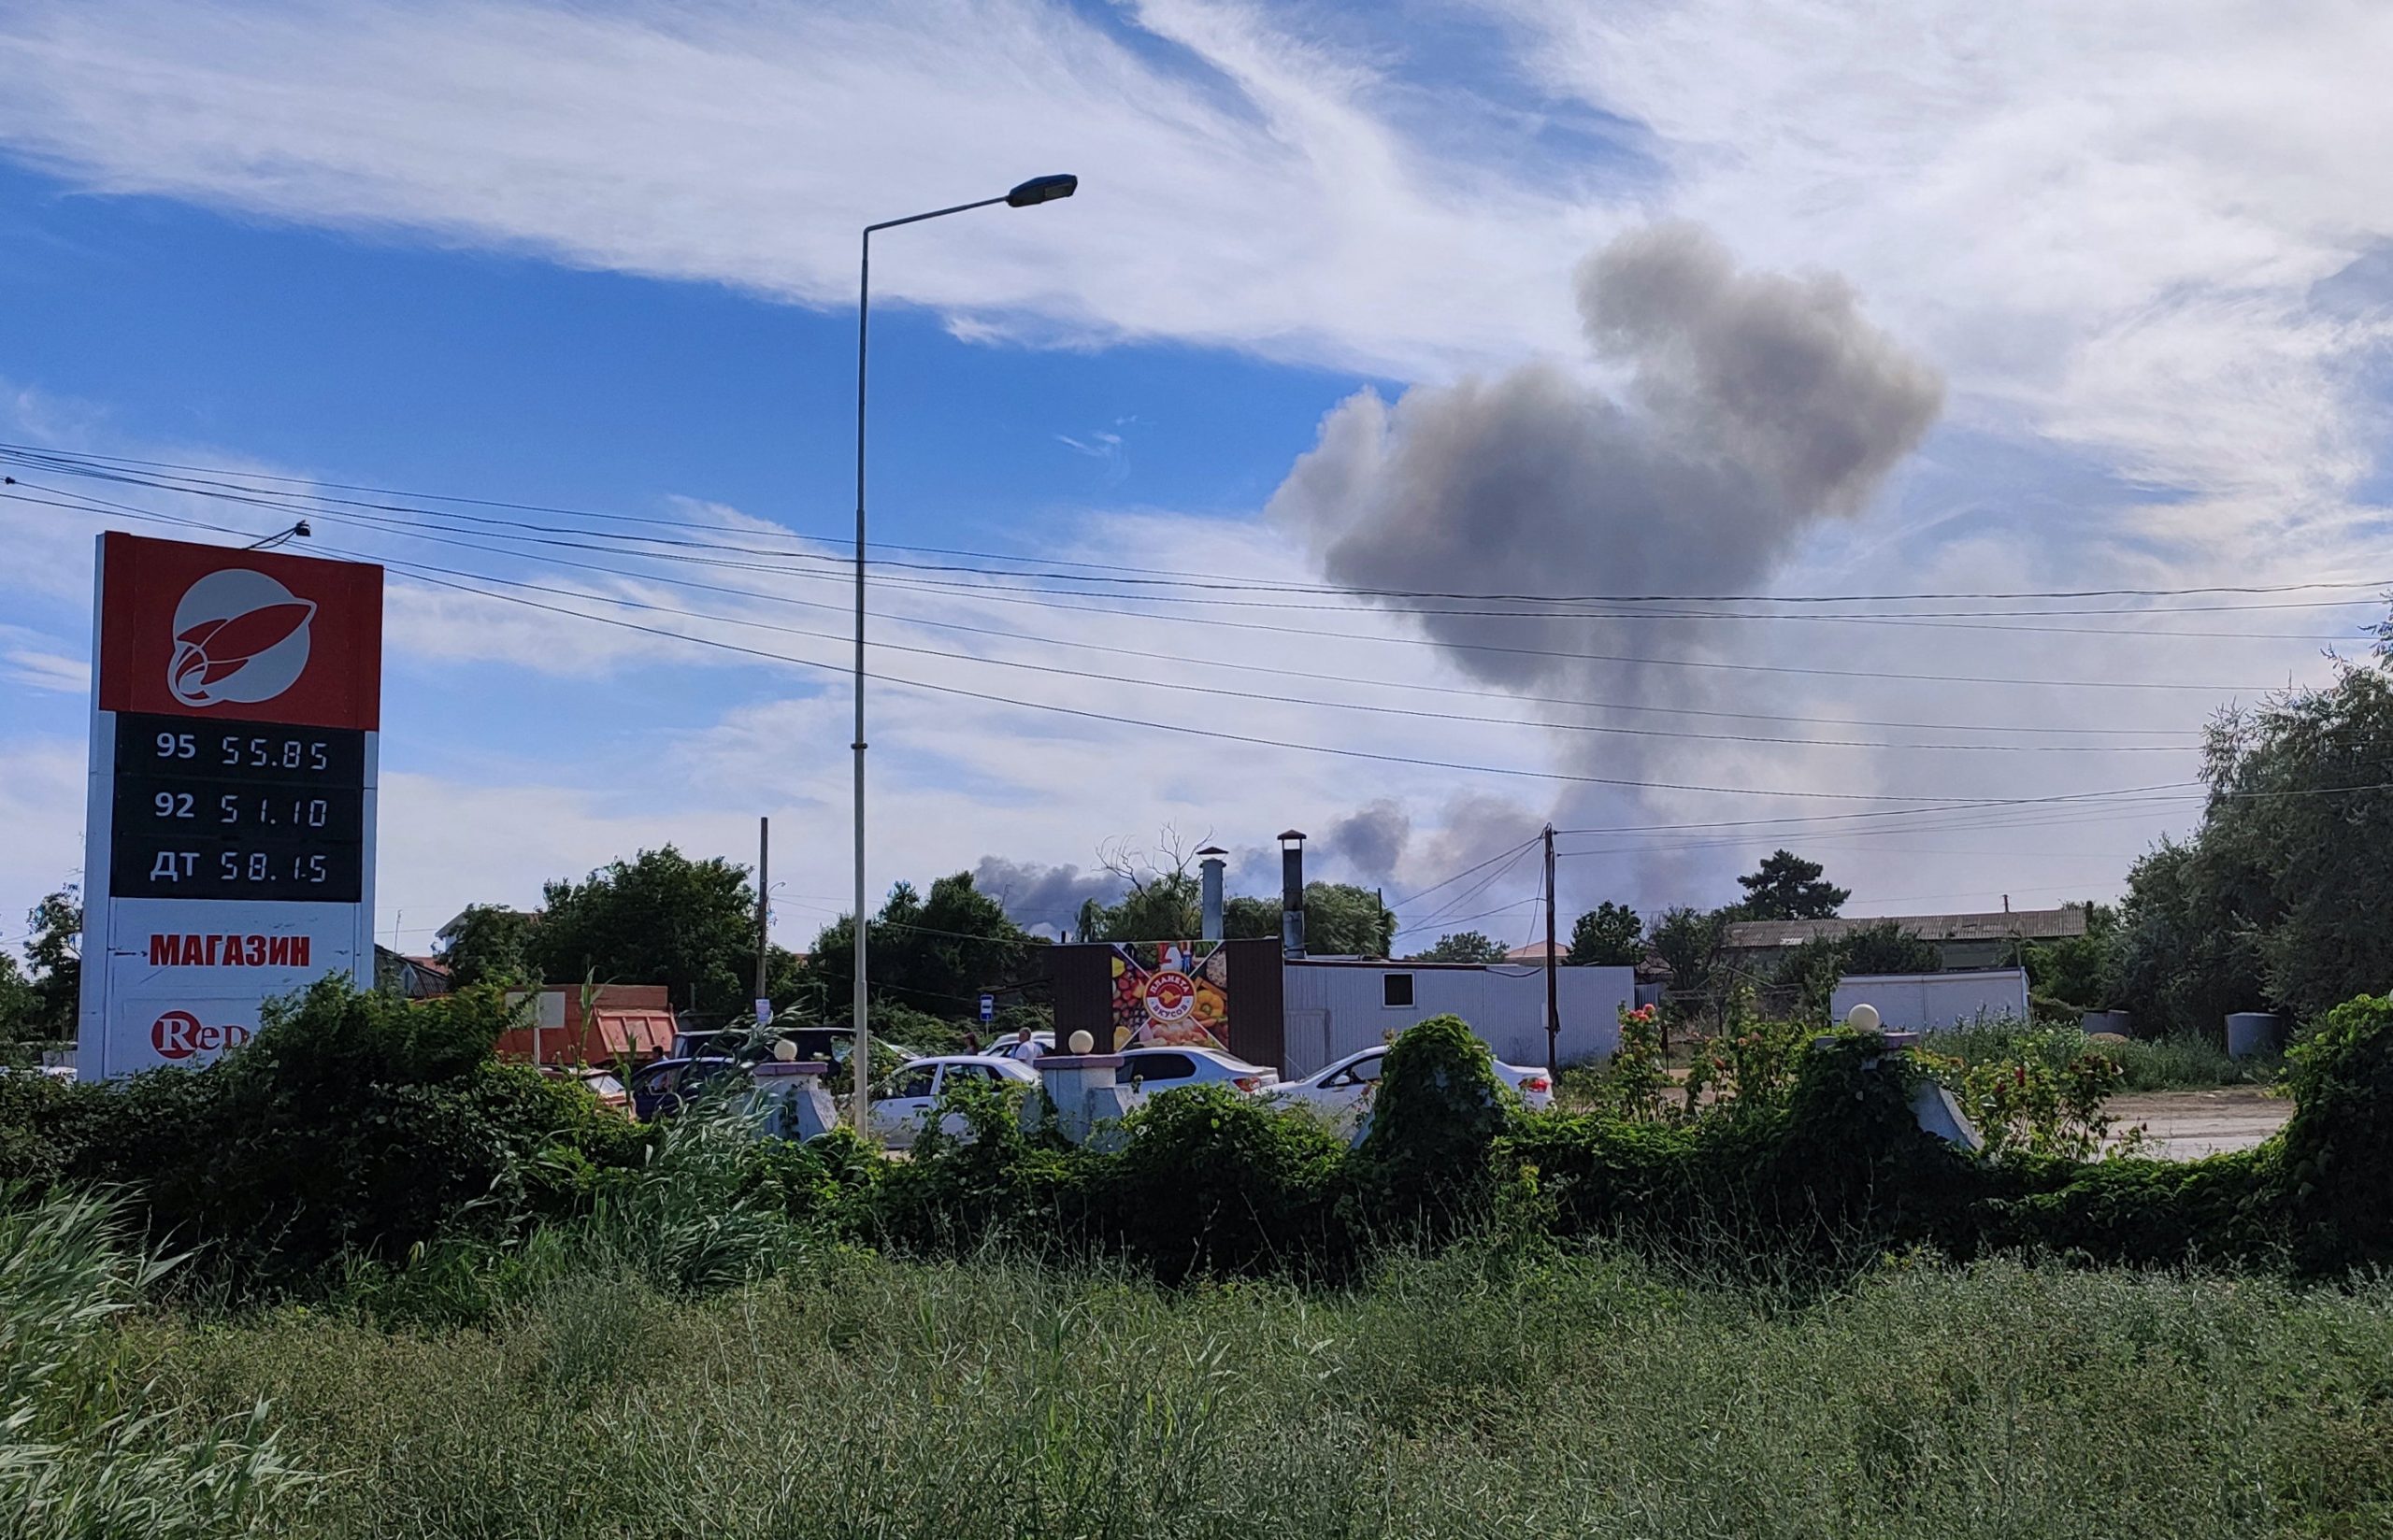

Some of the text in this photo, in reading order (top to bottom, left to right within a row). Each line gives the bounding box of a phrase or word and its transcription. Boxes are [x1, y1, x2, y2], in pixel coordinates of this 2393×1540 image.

[156, 733, 327, 770] 95 55.85
[154, 792, 327, 827] 92 51.10
[150, 851, 327, 882] ДТ 58.15
[150, 934, 310, 967] МАГАЗИН
[1150, 975, 1189, 994] ПЛАНЕТА
[1153, 1004, 1188, 1018] ВКУСОВ
